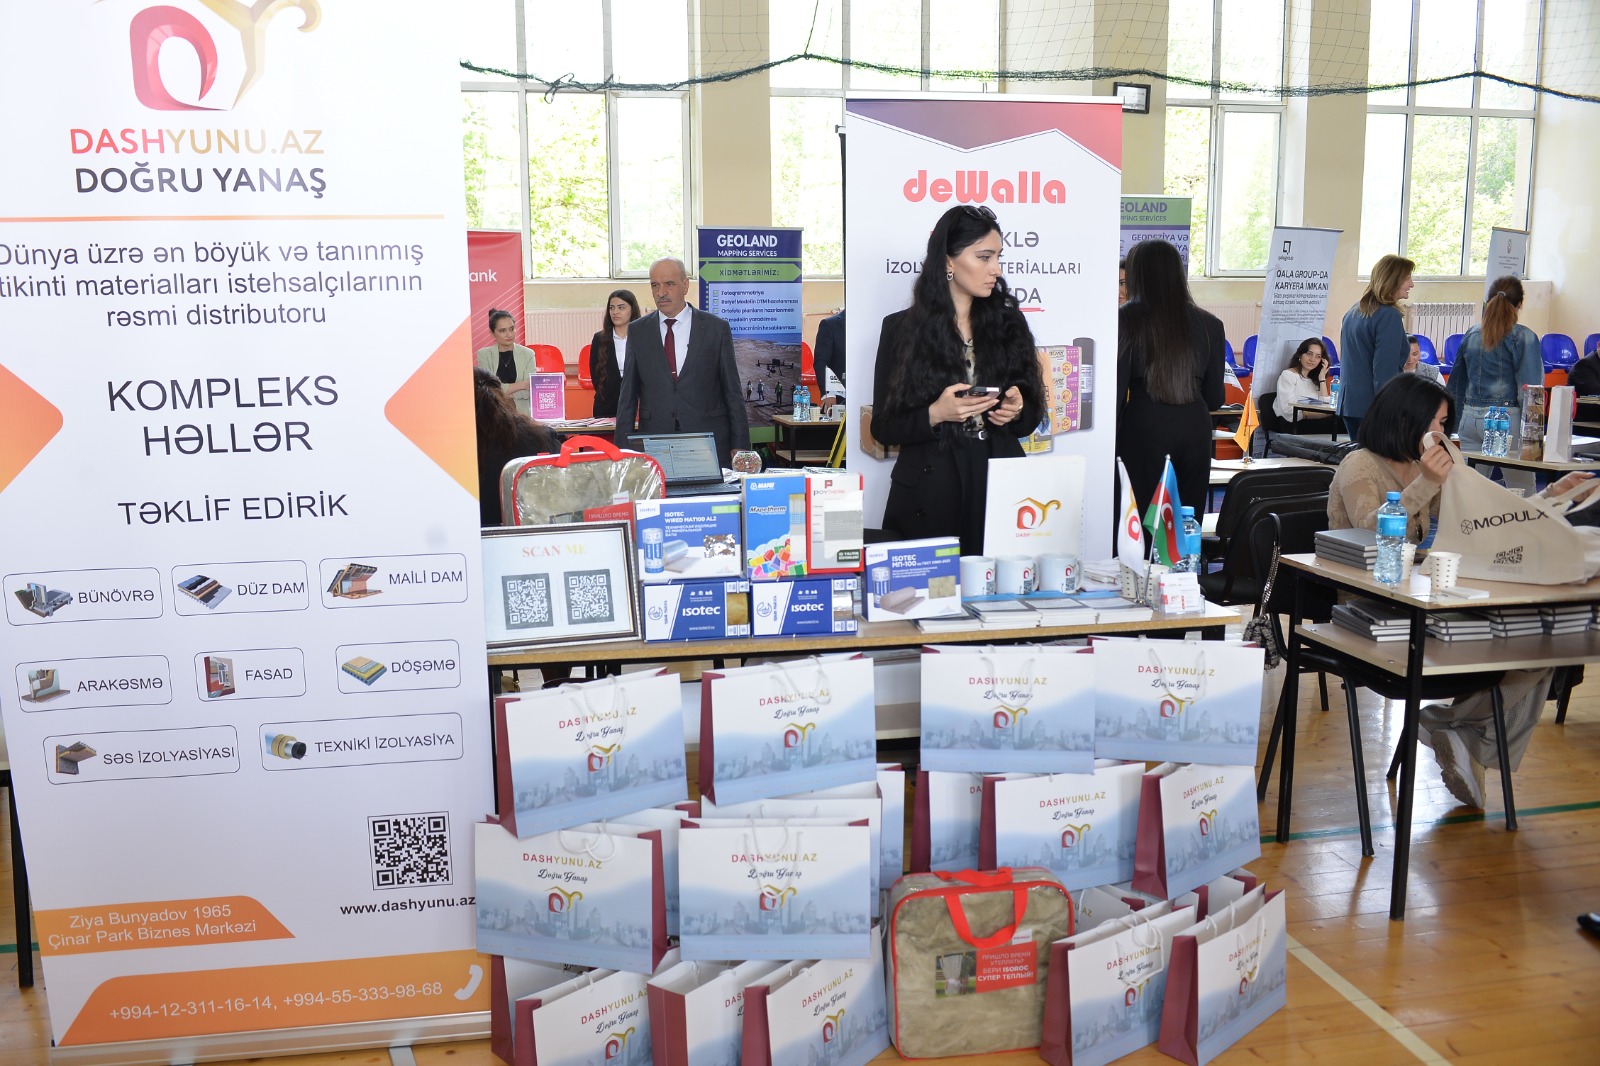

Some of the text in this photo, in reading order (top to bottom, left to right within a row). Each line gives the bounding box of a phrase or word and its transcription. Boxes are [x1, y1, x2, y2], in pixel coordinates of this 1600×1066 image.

[70, 128, 325, 154] DASHYUNU.AZ
[75, 161, 326, 198] DOĞRU YANAŞ
[903, 170, 1066, 204] deWalla
[1120, 202, 1167, 212] EOLAND
[716, 234, 778, 248] GEOLAND
[0, 241, 424, 270] Dünya üzrə ən böyük və tanınmış
[469, 268, 498, 282] ank
[1276, 270, 1328, 279] QALA GROUP-DA
[0, 272, 423, 298] tikinti materialları istehsalçılarının
[1274, 280, 1328, 290] KARYERA İMKANI
[107, 304, 326, 326] rəsmi distributoru
[108, 375, 340, 412] KOMPLEKS
[143, 421, 314, 456] HƏLLƏR
[118, 490, 348, 525] TƏKLİF EDİRİK
[1473, 508, 1549, 530] MODULX
[522, 544, 588, 558] SCAN ME
[389, 570, 463, 585] MAİLİ DAM
[78, 587, 155, 604] BÜNÖVRƏ
[237, 580, 306, 596] DÜZ DAM
[682, 606, 720, 616] isotec
[791, 602, 824, 612] isotec
[245, 668, 294, 682] FASAD
[391, 658, 456, 675] DÖŞƏMƏ
[77, 676, 164, 693] ARAKƏSMƏ
[314, 733, 455, 754] TEXNİKİ İZOLYASİYA
[103, 746, 236, 766] SƏS İZOLYASİYASI
[1040, 792, 1106, 808] DASHYUNU.AZ
[523, 853, 602, 869] DASHYUNU.AZ
[340, 896, 476, 916] www.dashyunu.az
[69, 904, 232, 930] Ziya Bunyadov 1965
[48, 920, 256, 950] Çinar Park Biznes Mərkəzi
[802, 968, 853, 1008] DASHYUNU.AZ
[110, 982, 443, 1020] +994-12-311-16-14, +994-55-333-98-68
